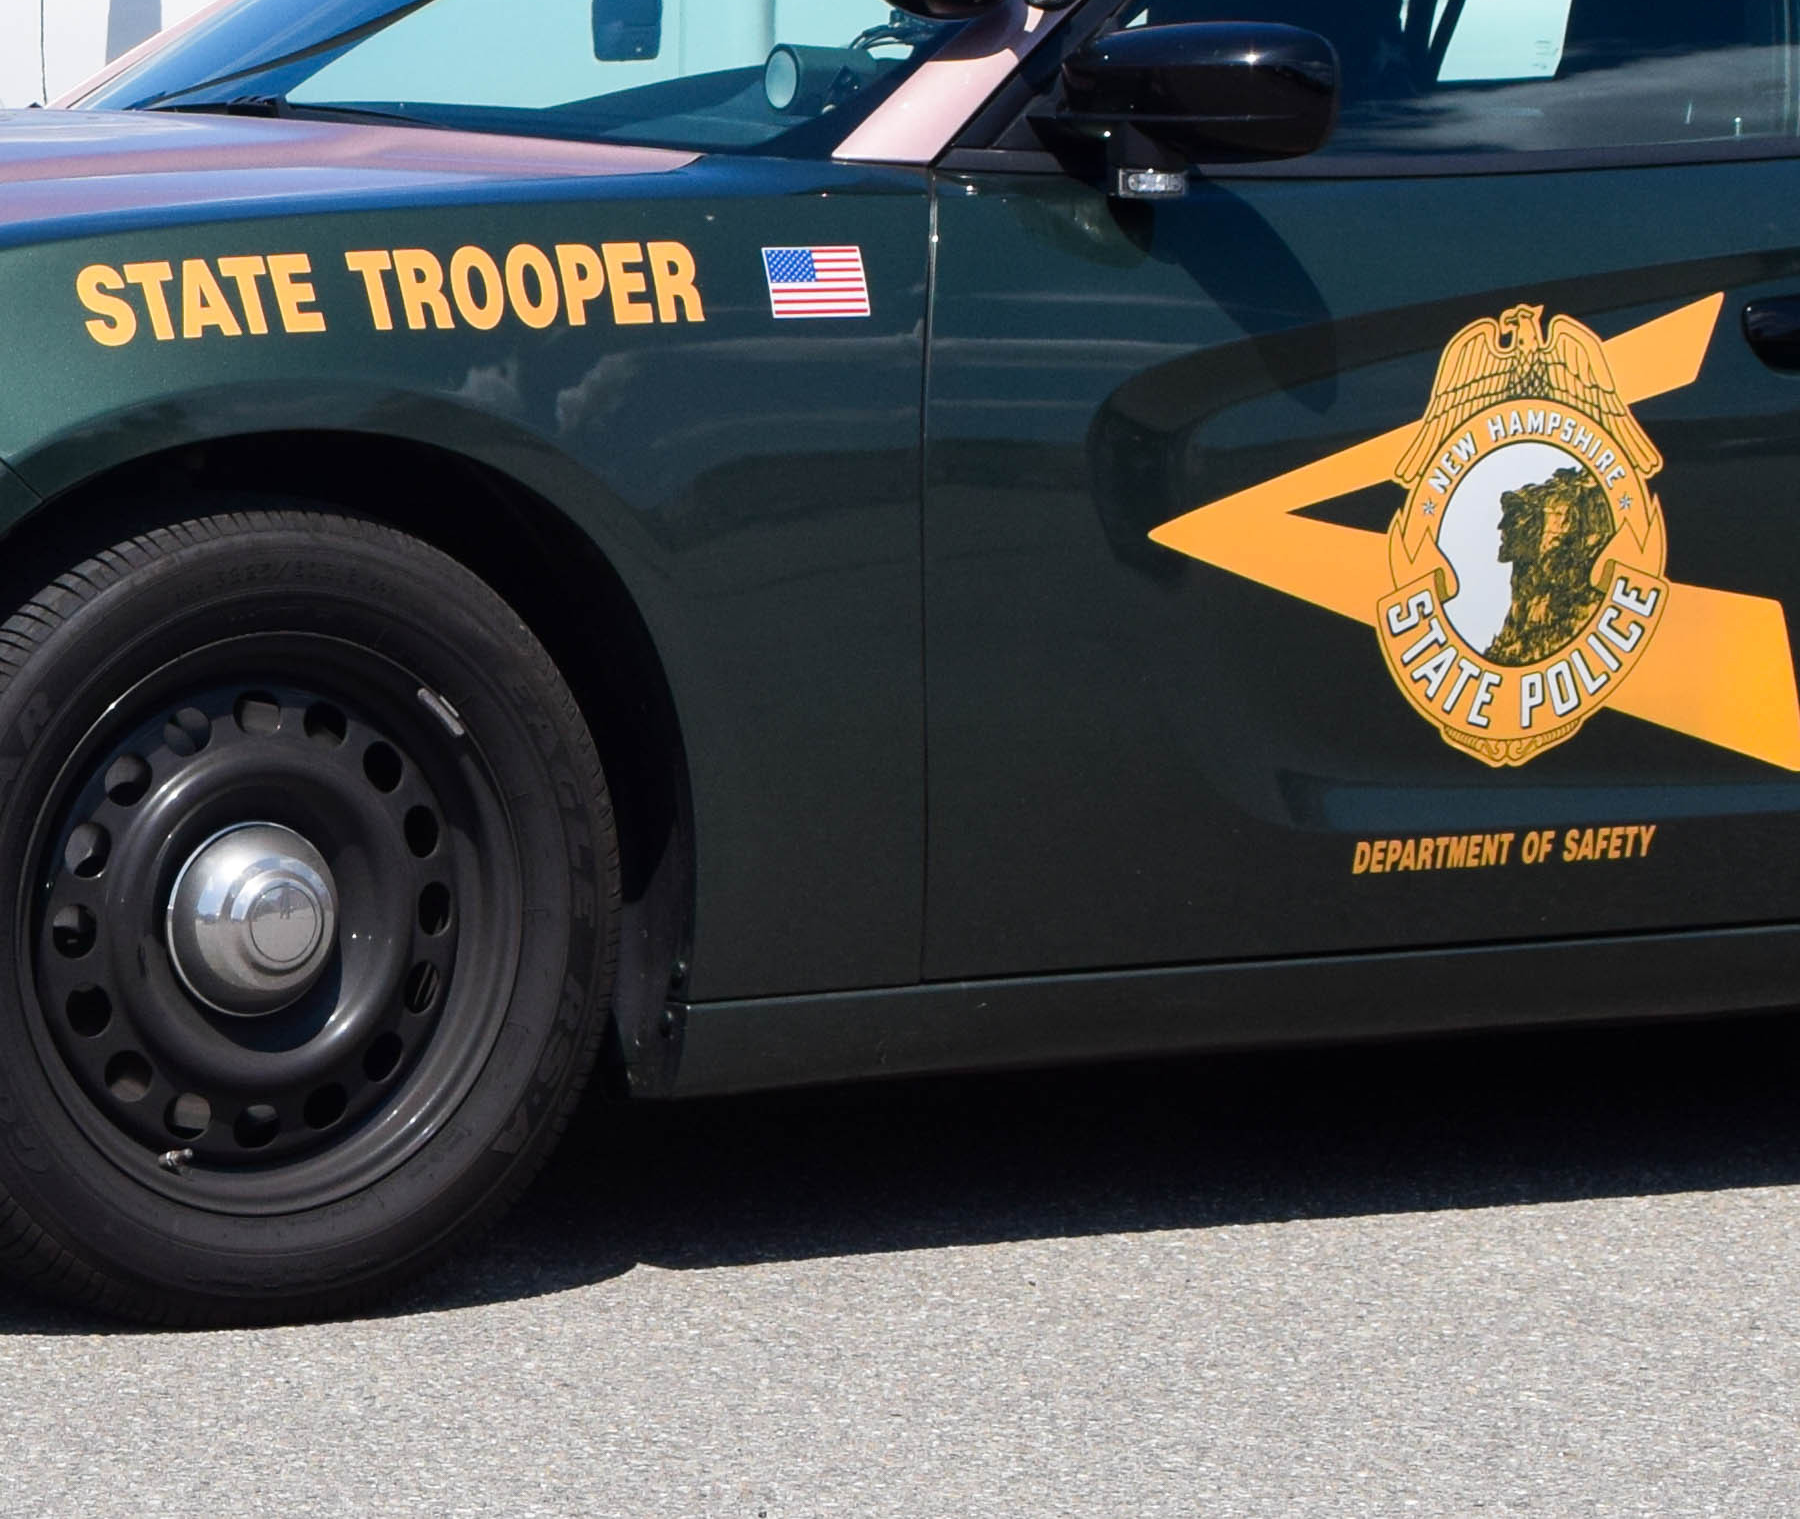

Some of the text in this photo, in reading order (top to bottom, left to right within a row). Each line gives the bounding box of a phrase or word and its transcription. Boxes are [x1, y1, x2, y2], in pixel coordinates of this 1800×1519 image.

[76, 240, 705, 347] STATE TROOPER
[1428, 409, 1626, 494] NEW HAMPSHIRE
[1387, 577, 1660, 729] STATE POLICE
[1352, 824, 1657, 875] DEPARTMENT OF SAFETY
